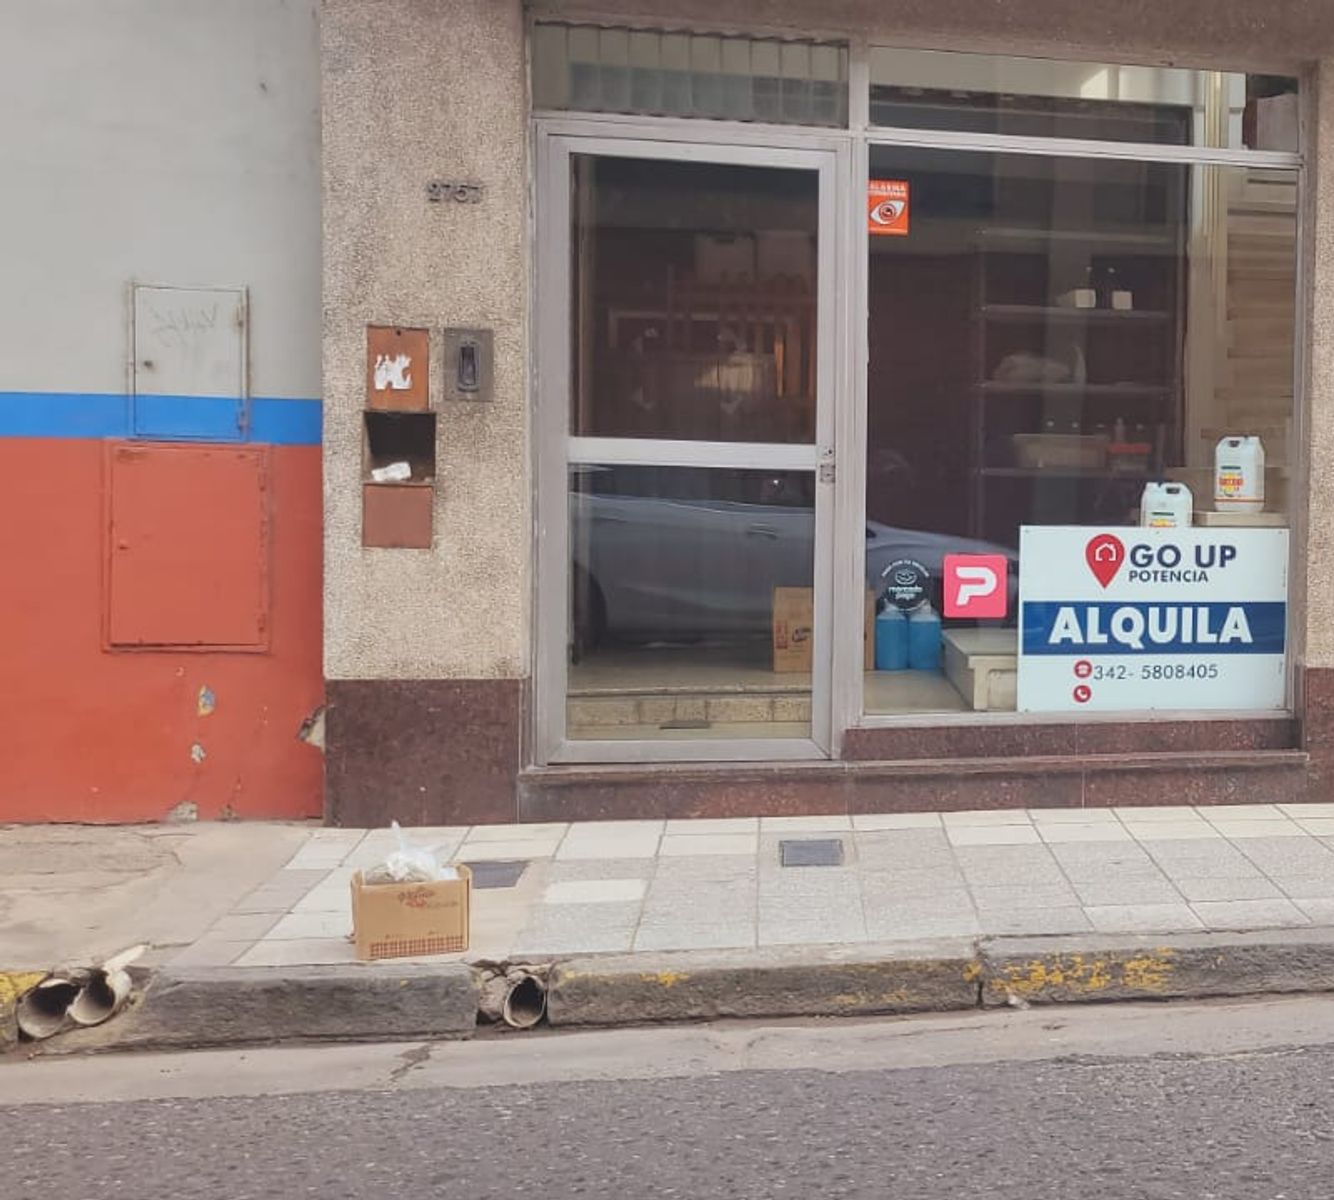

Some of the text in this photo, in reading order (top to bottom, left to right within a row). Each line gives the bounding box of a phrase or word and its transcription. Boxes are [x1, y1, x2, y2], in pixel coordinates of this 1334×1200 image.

[1130, 544, 1237, 568] GO UP
[1129, 570, 1209, 583] POTENCIA
[1048, 606, 1253, 650] ALQUILA
[1093, 664, 1219, 680] 342- 5808405
